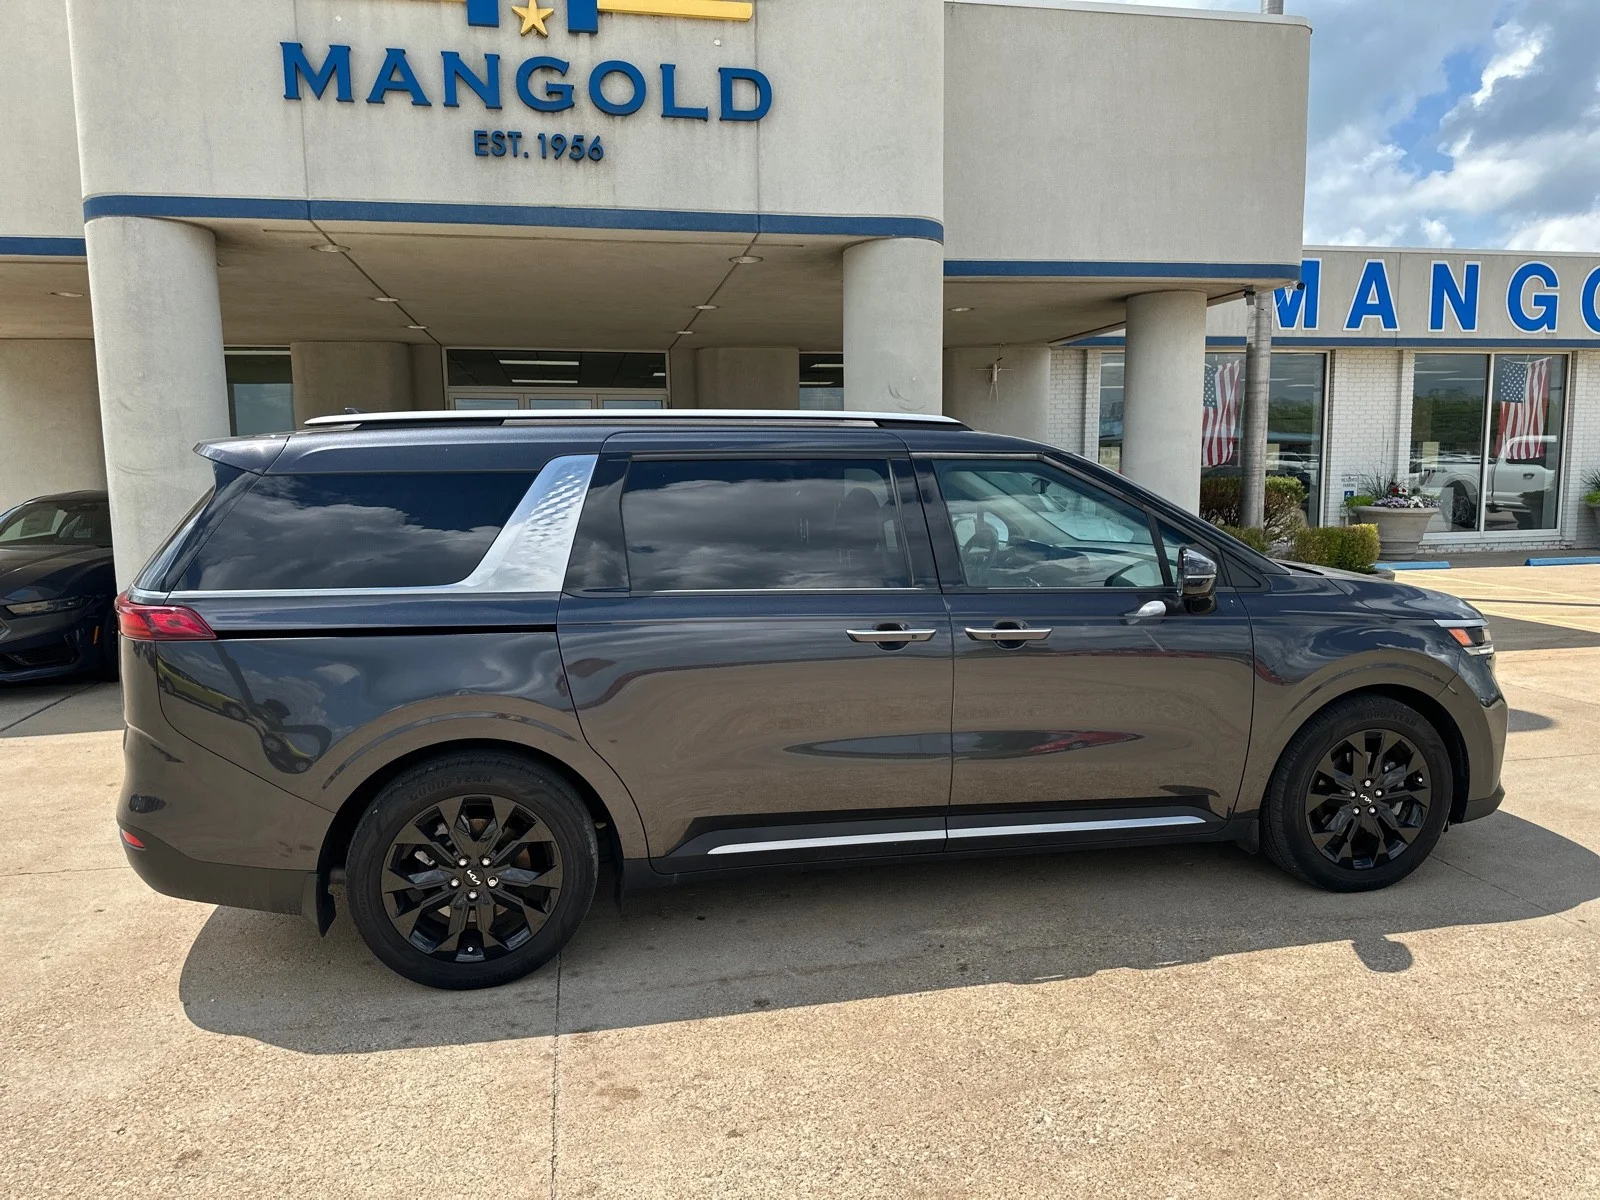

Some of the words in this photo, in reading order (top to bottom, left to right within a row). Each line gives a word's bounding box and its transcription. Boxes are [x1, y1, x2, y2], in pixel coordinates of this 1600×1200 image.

[279, 41, 773, 122] MANGOLD
[473, 130, 529, 158] EST.
[537, 132, 604, 161] 1956
